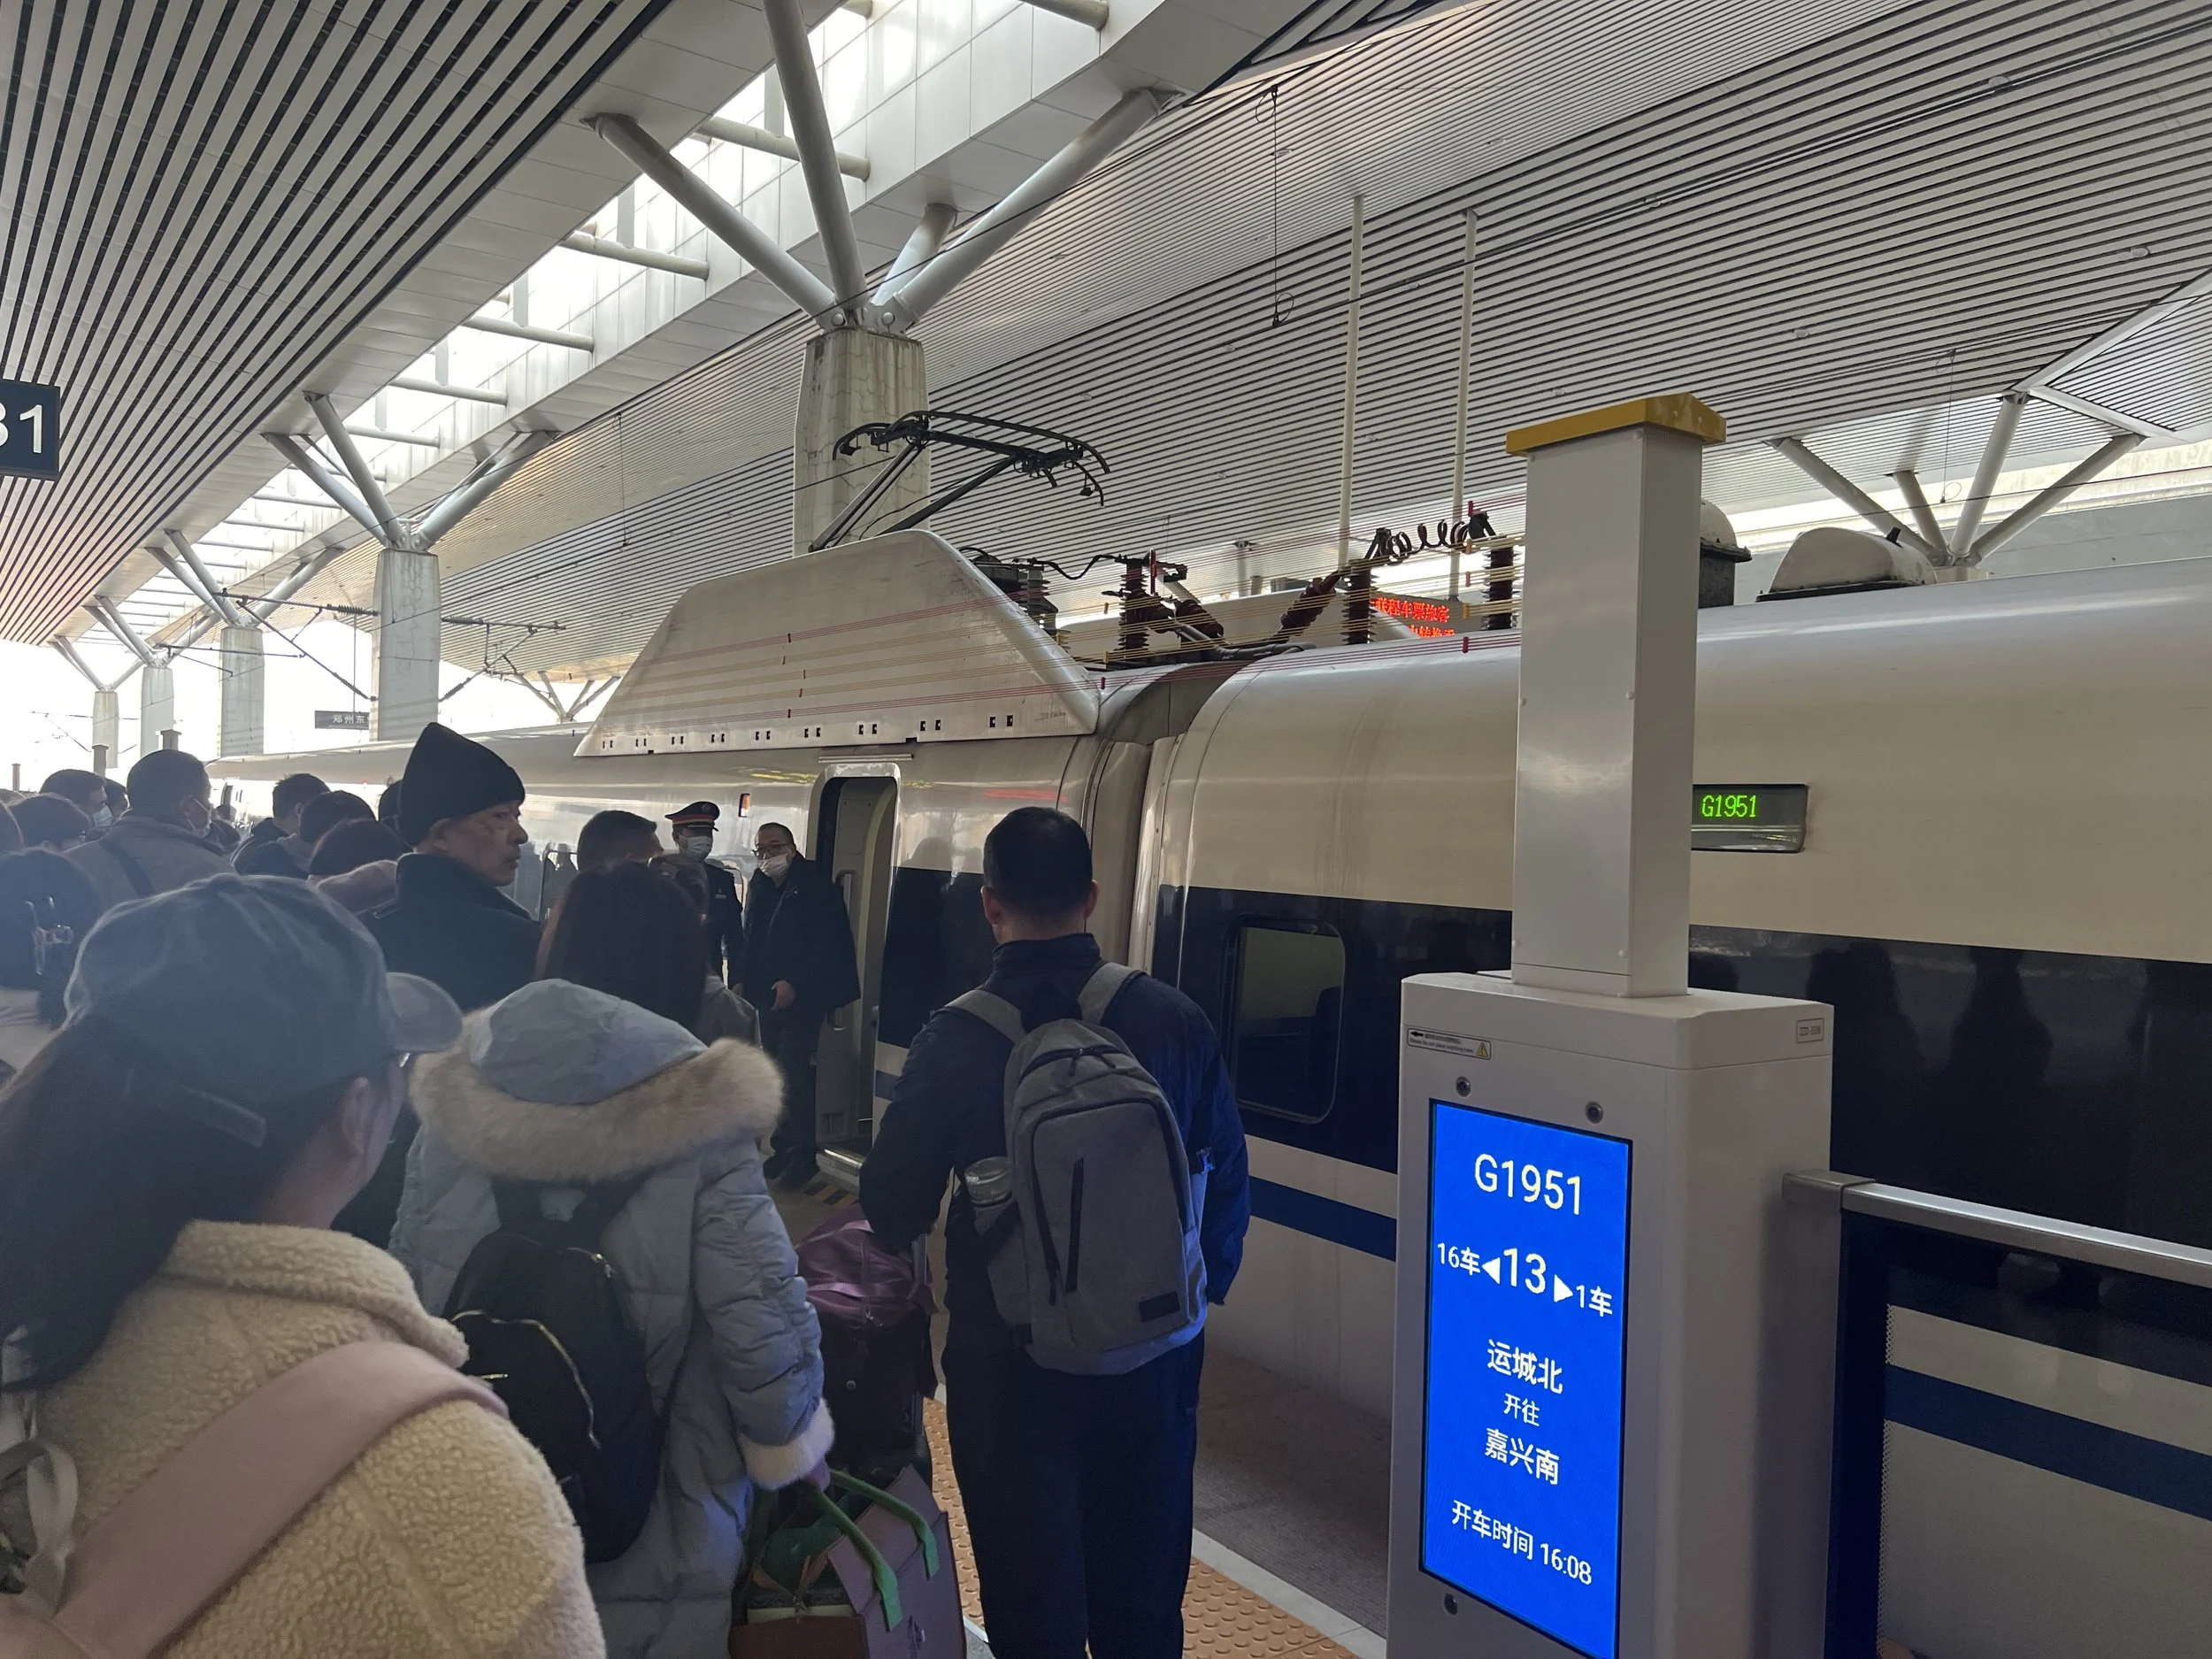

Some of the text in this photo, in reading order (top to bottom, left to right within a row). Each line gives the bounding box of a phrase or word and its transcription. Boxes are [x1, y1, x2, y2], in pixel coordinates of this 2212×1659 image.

[0, 402, 42, 453] 1
[333, 714, 369, 725] 郑州东
[1701, 795, 1756, 818] G1951
[1474, 1153, 1581, 1216] G1951
[1437, 1242, 1613, 1317] 16车 13 1车
[1486, 1339, 1563, 1394] 运城北
[1503, 1393, 1540, 1427] 开往
[1484, 1427, 1560, 1486] 嘉兴南
[1451, 1500, 1592, 1585] 开车时间 16:08
